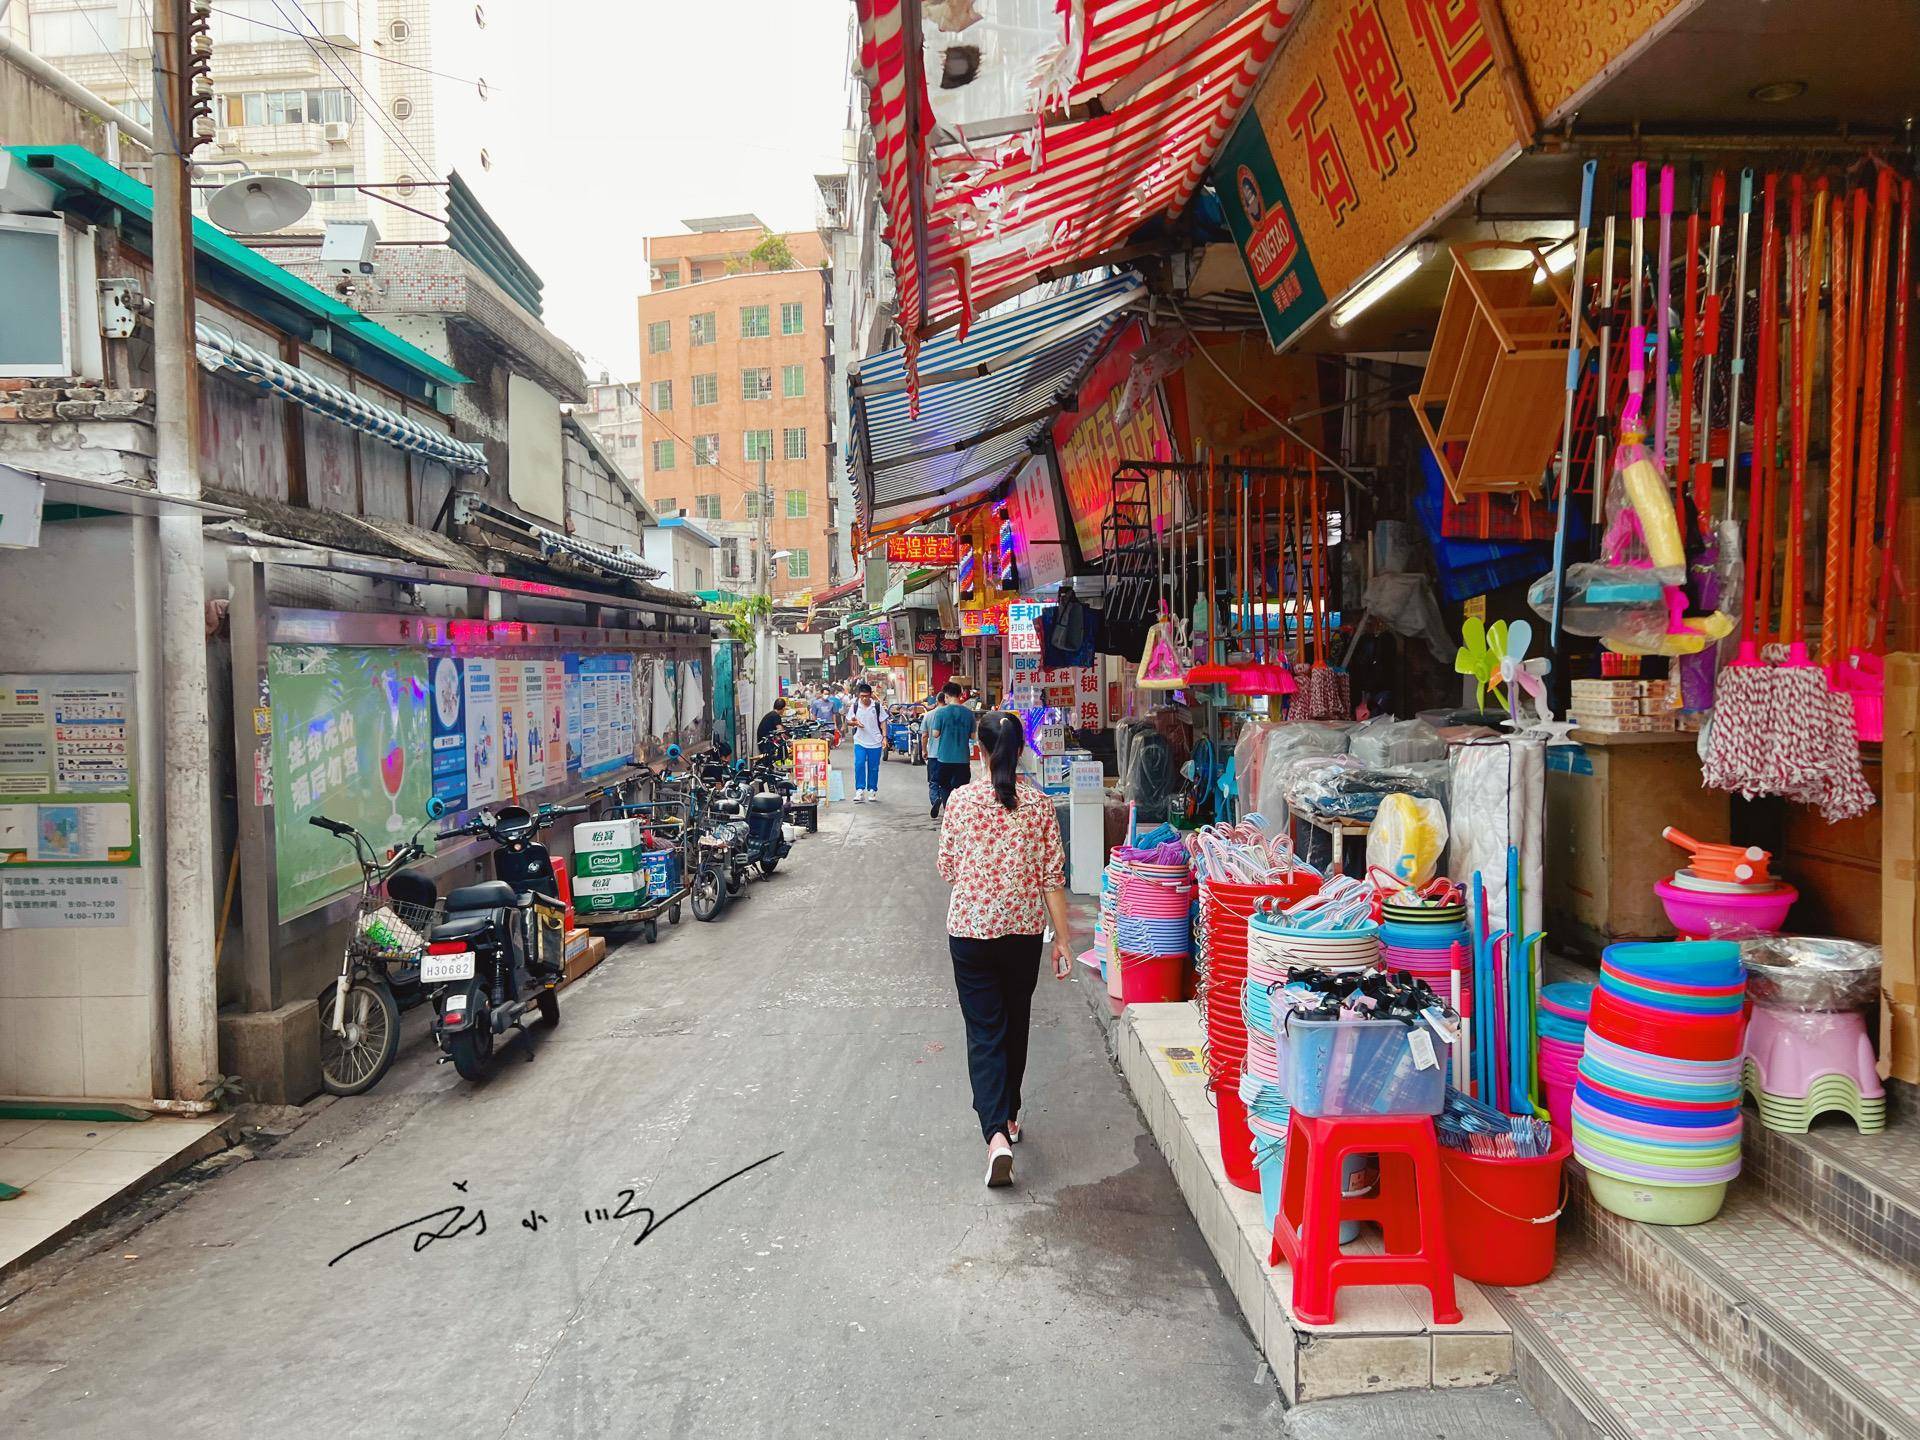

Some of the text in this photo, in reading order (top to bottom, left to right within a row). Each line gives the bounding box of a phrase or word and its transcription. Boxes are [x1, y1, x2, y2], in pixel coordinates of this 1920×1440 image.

[1250, 217, 1290, 277] TSINGTAO
[889, 536, 955, 559] 辉煌造型
[1015, 658, 1042, 670] 回收
[1044, 728, 1063, 738] 打印
[426, 963, 469, 976] H30682
